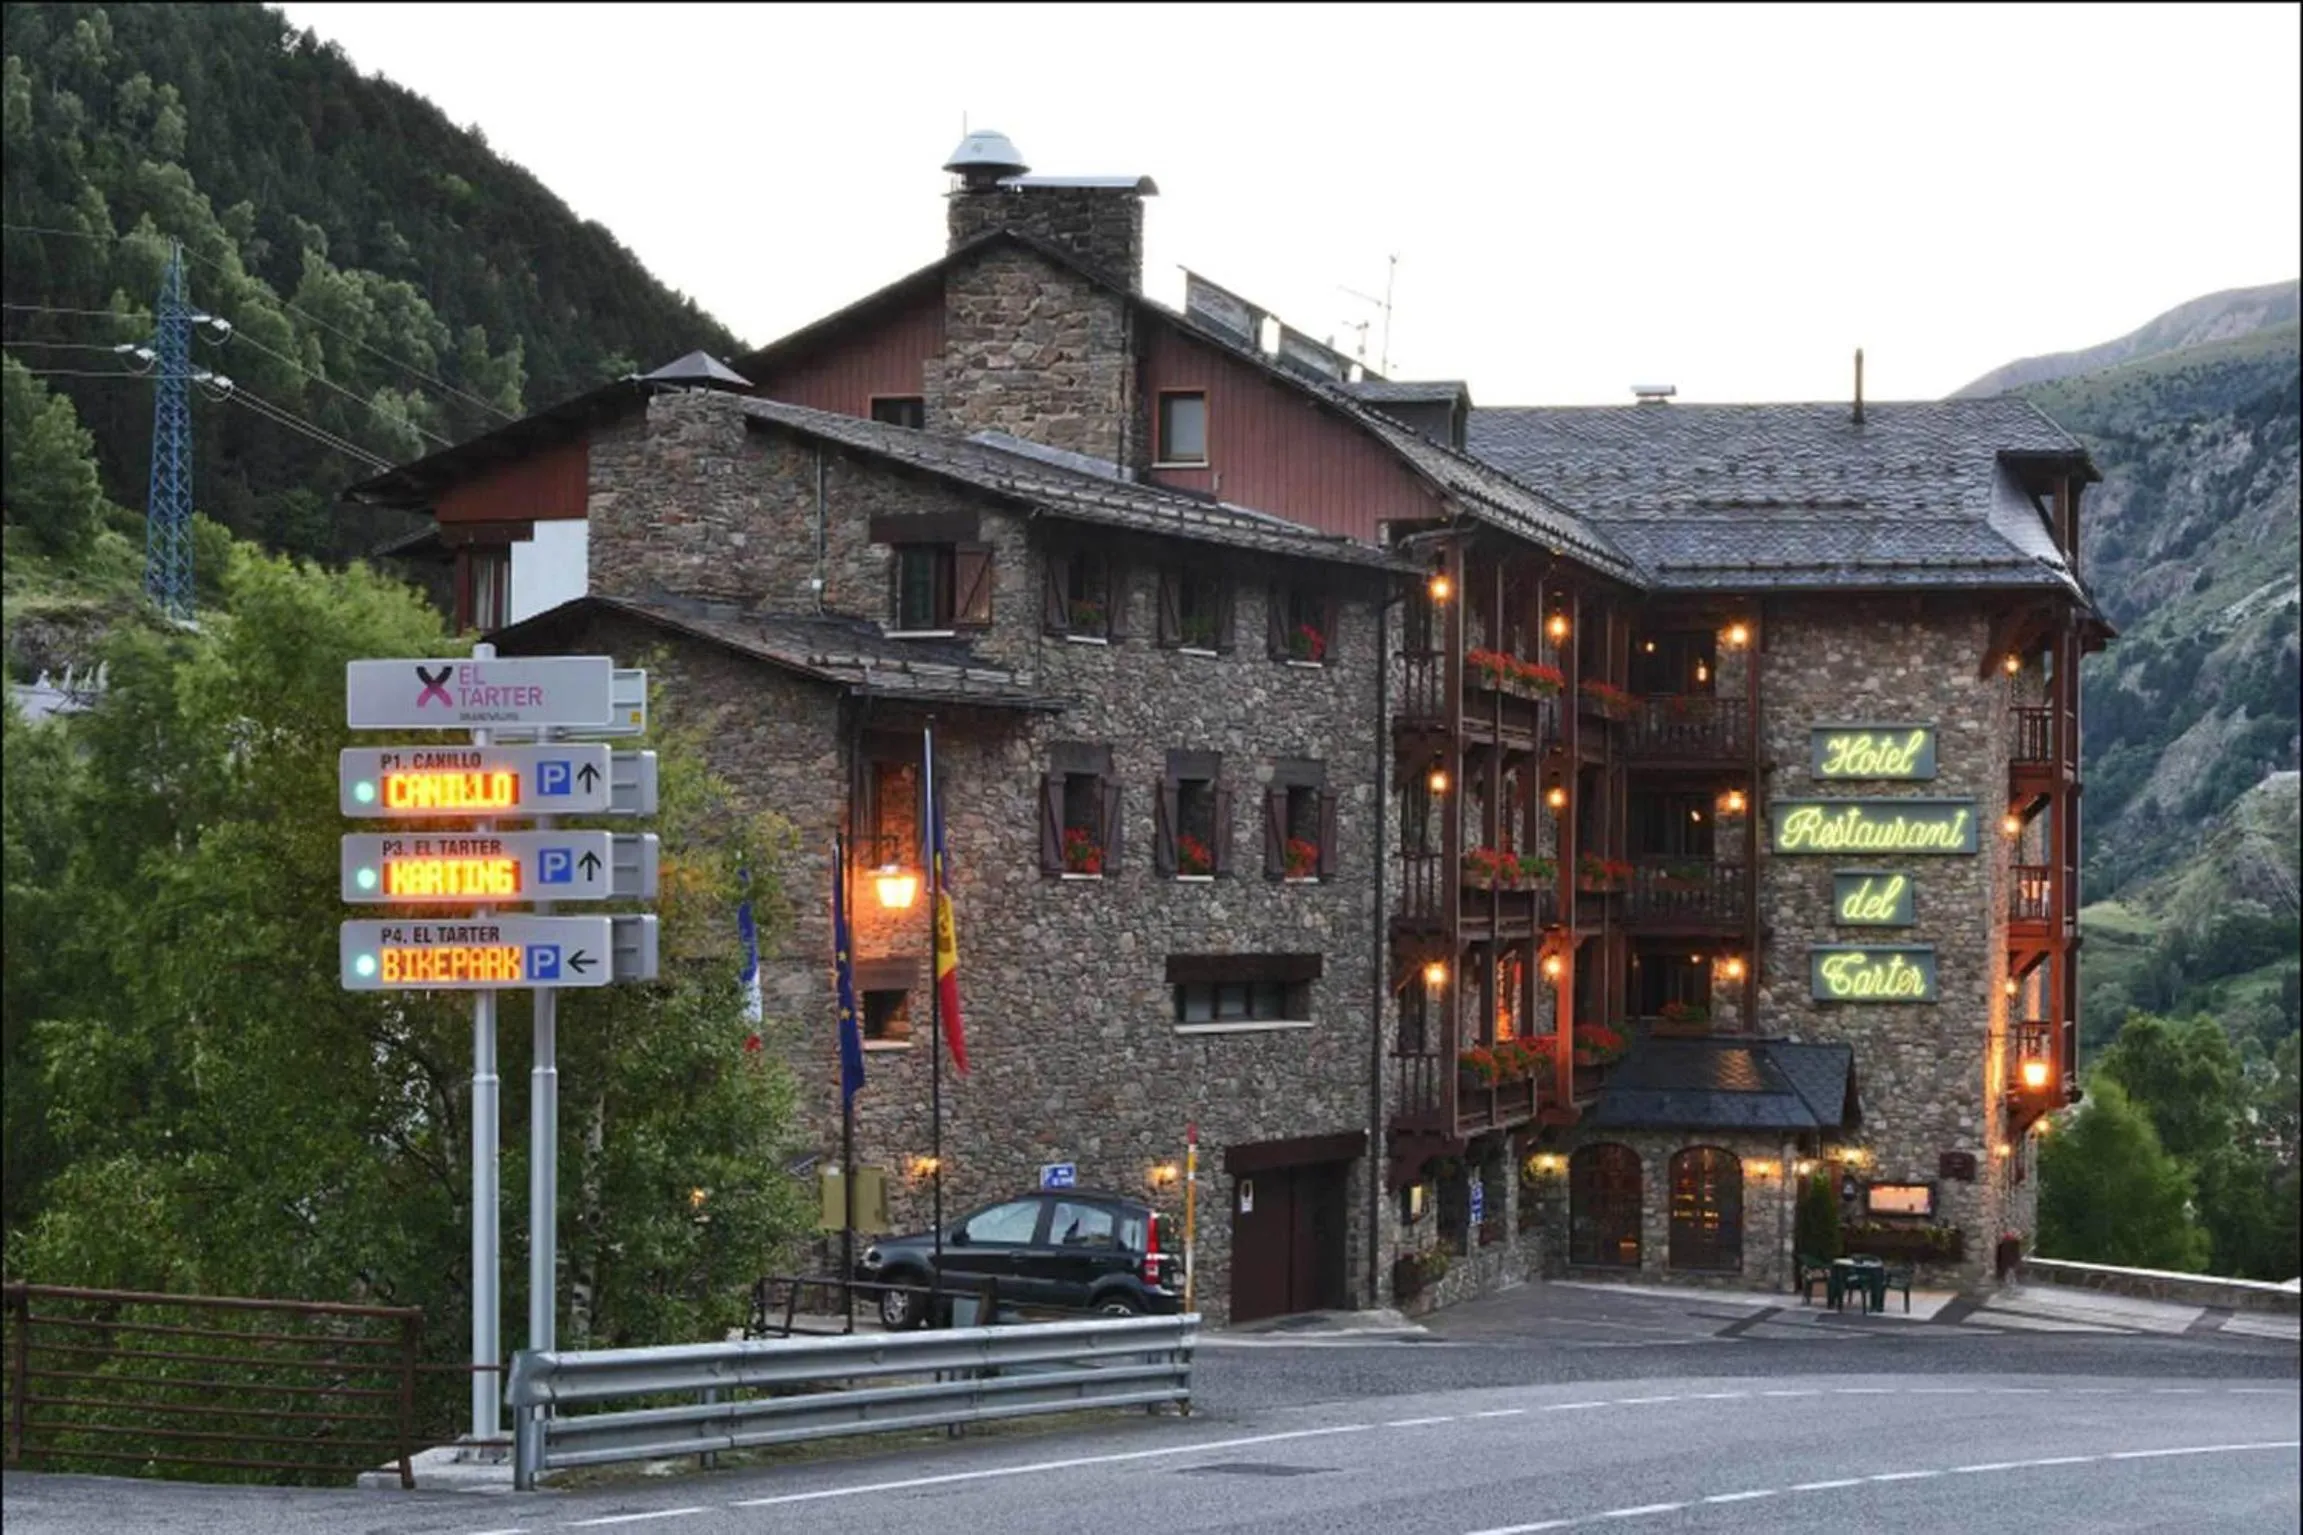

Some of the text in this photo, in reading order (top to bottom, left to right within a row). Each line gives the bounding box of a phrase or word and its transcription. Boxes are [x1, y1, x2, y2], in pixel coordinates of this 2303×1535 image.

[459, 665, 486, 685] EL
[458, 686, 543, 707] TARTER
[1820, 730, 1925, 776] Hotel
[390, 772, 512, 808] CANILLO
[542, 764, 566, 792] P
[1779, 807, 1970, 849] Restaurant
[414, 840, 433, 856] EL
[438, 839, 502, 856] TARTER
[390, 860, 515, 895] KARTING
[544, 852, 568, 881] P
[1841, 875, 1905, 920] del
[413, 926, 433, 943] EL
[437, 926, 500, 943] TARTER
[381, 947, 521, 982] BIKEPARK
[533, 949, 557, 977] P
[1821, 952, 1926, 996] Tarter
